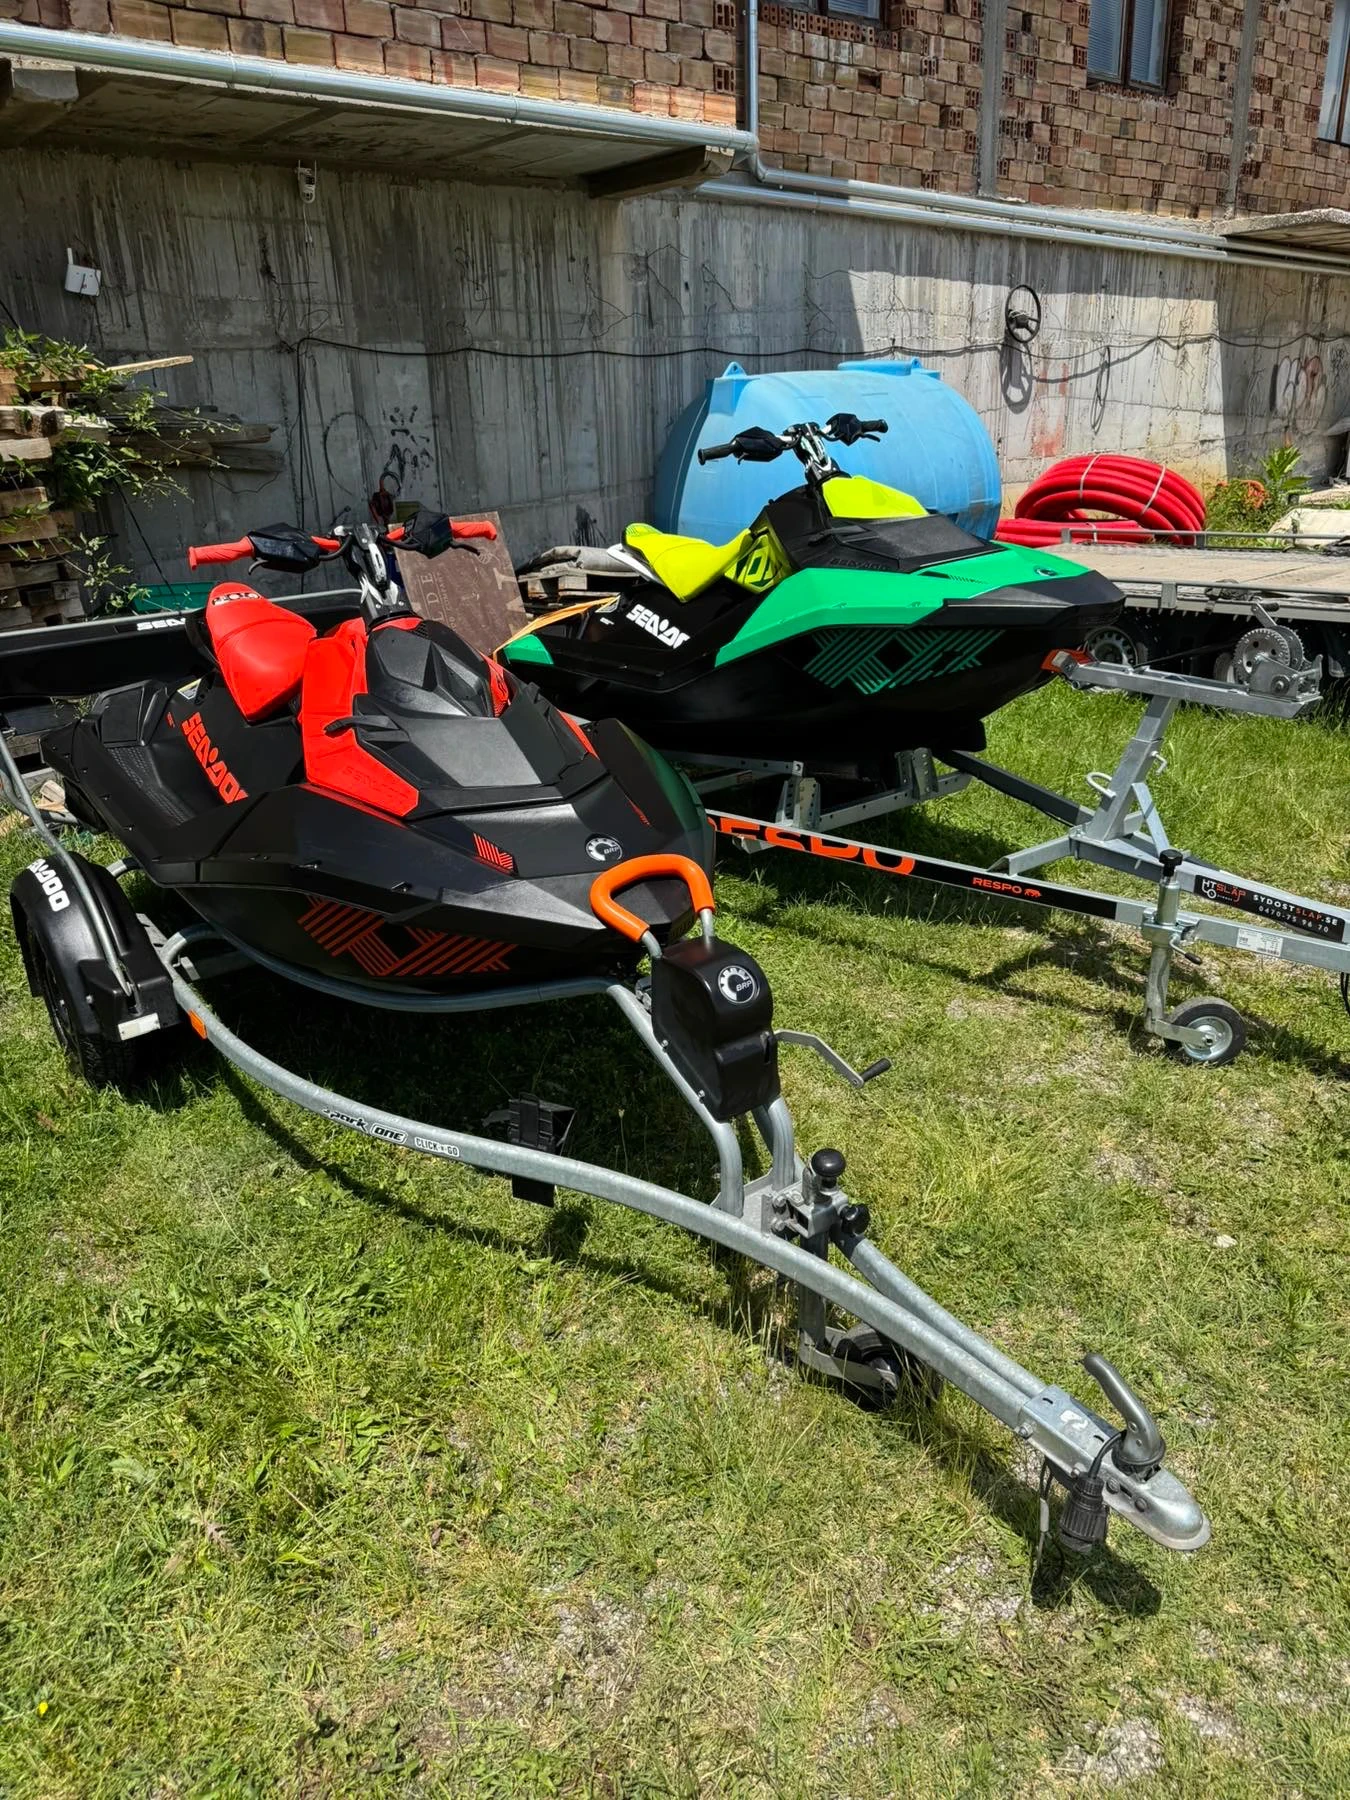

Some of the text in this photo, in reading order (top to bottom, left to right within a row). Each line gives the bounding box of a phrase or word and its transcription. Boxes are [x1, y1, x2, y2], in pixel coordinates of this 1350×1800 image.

[972, 876, 1023, 894] RESPO
[1318, 924, 1329, 933] 70
[736, 980, 752, 992] BRP
